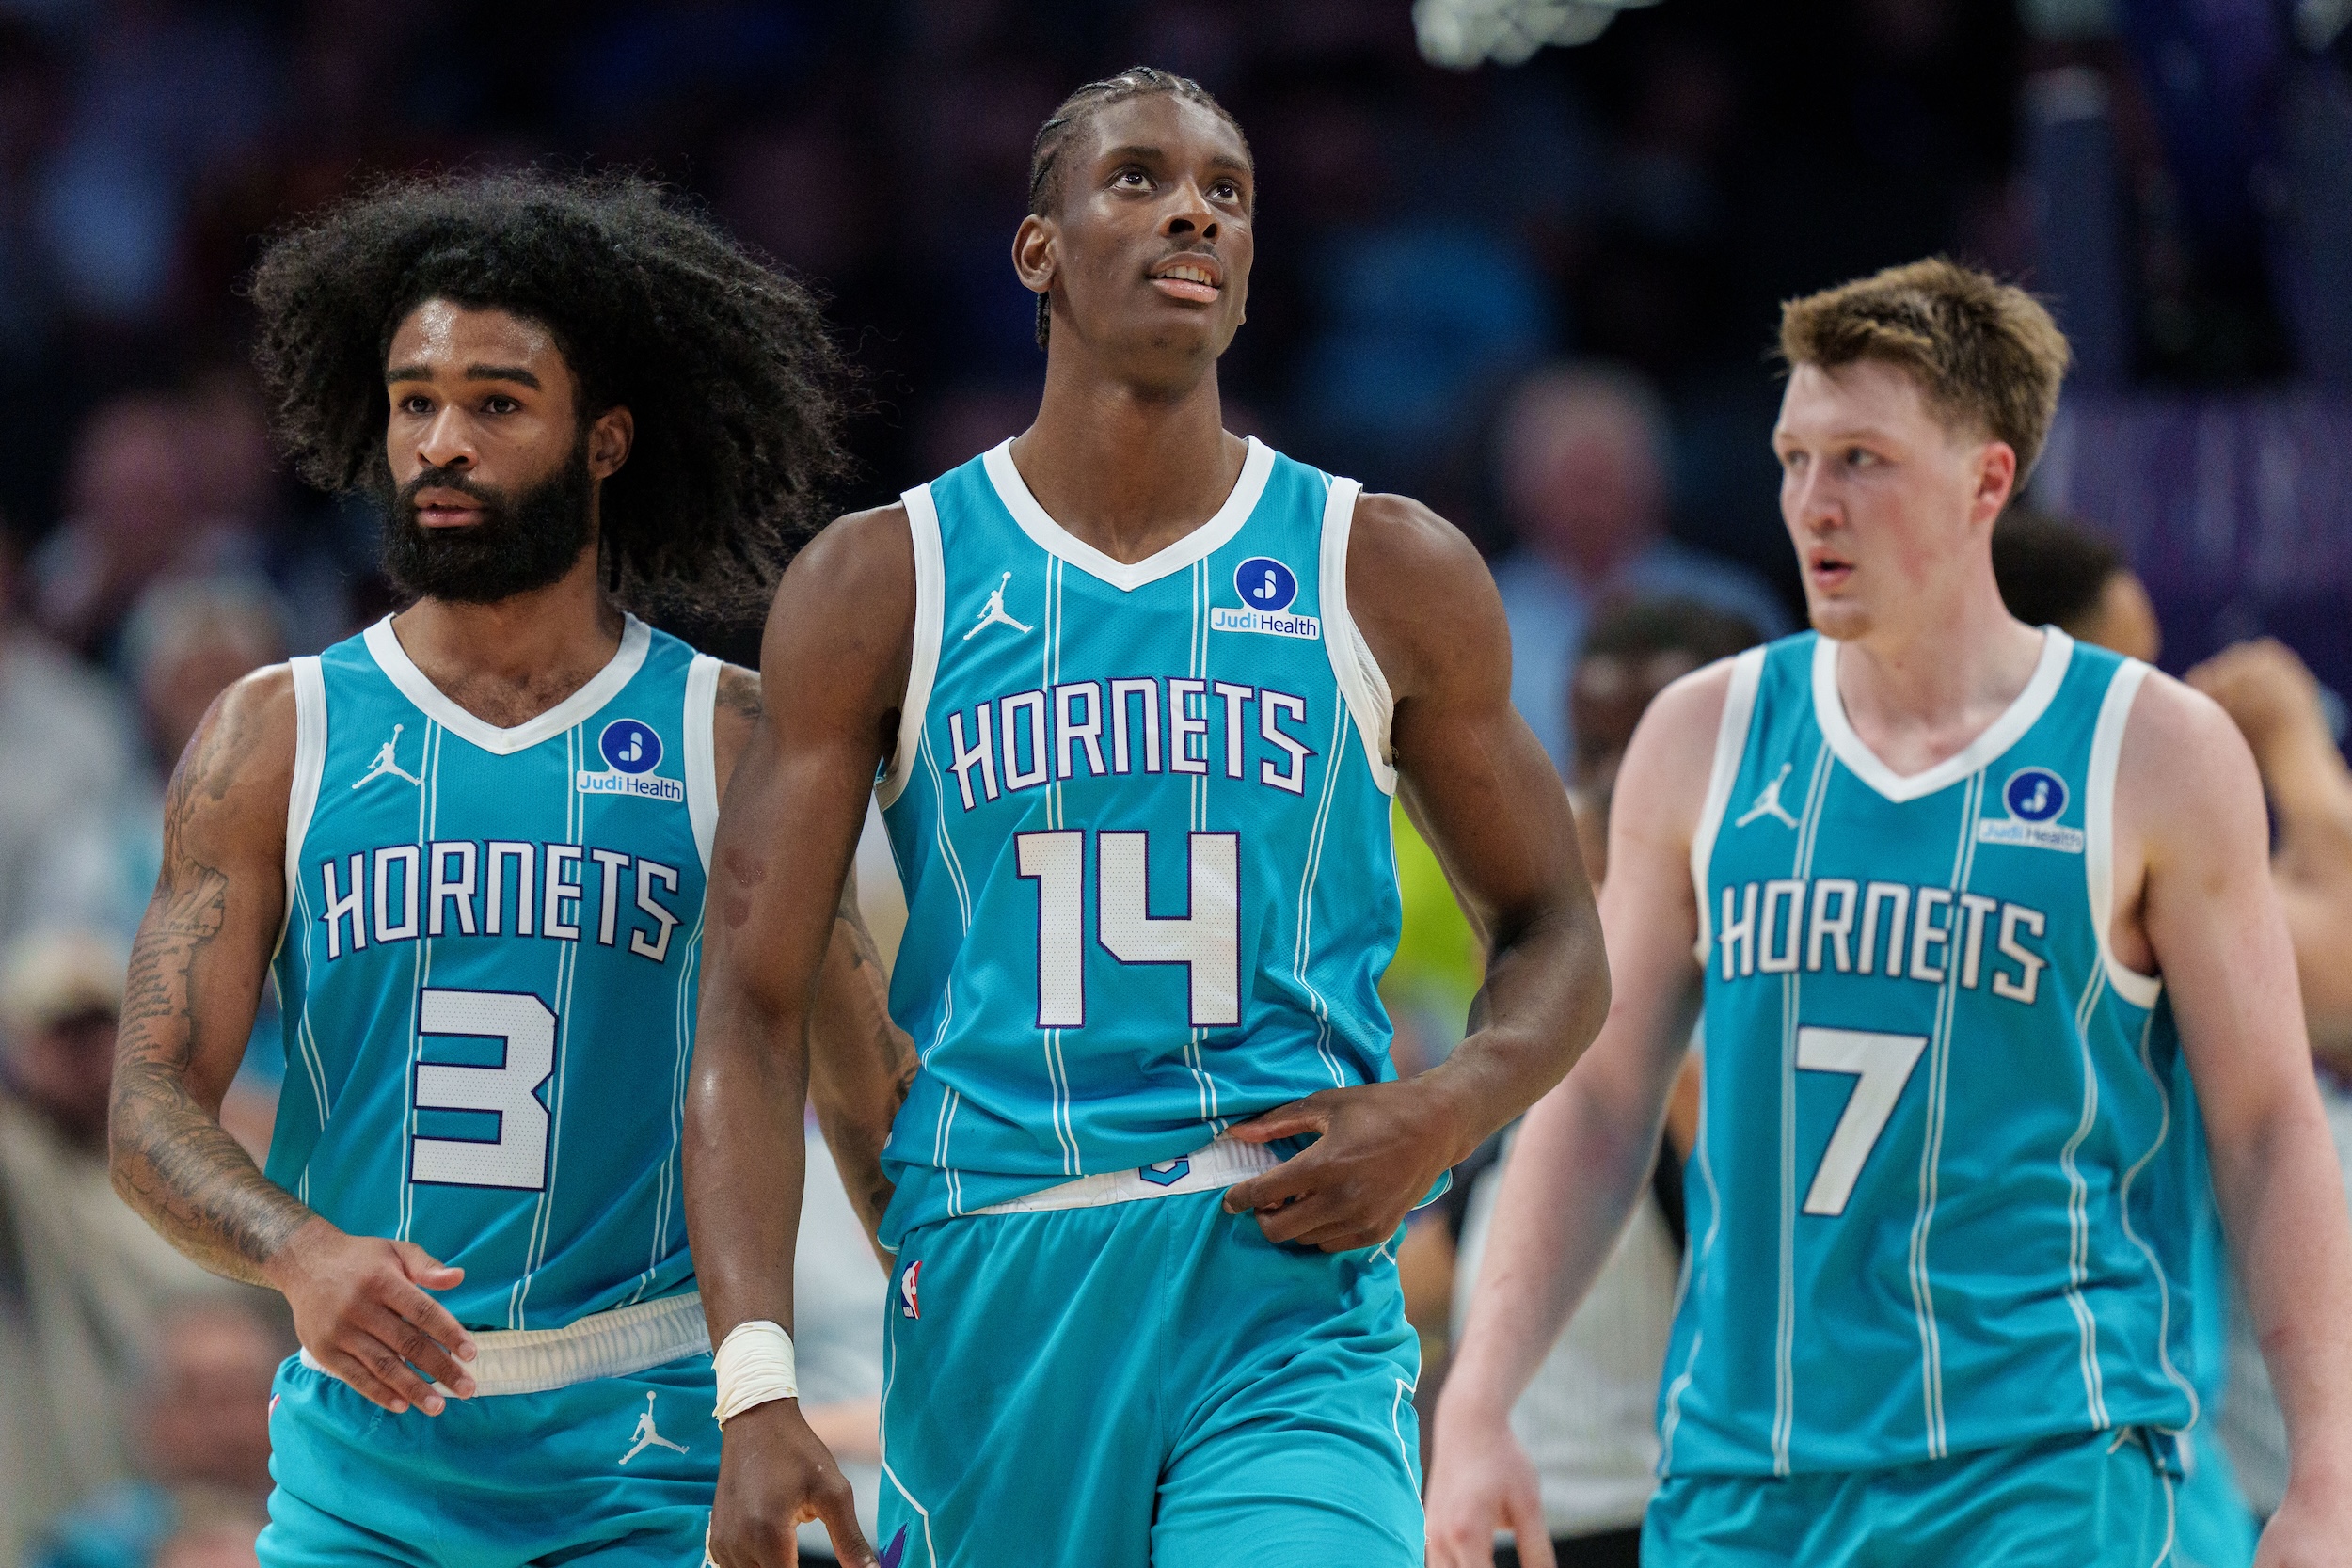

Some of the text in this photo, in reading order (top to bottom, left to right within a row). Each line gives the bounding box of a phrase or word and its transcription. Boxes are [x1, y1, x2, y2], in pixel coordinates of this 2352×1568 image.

[1214, 611, 1316, 637] Judi Health
[580, 774, 681, 800] Judi Health
[946, 675, 1318, 813] HORNETS
[319, 839, 684, 963] HORNETS
[1013, 829, 1242, 1030] 14
[1718, 879, 2049, 1006] HORNETS
[408, 987, 559, 1192] 3
[1794, 1023, 1931, 1219] 7
